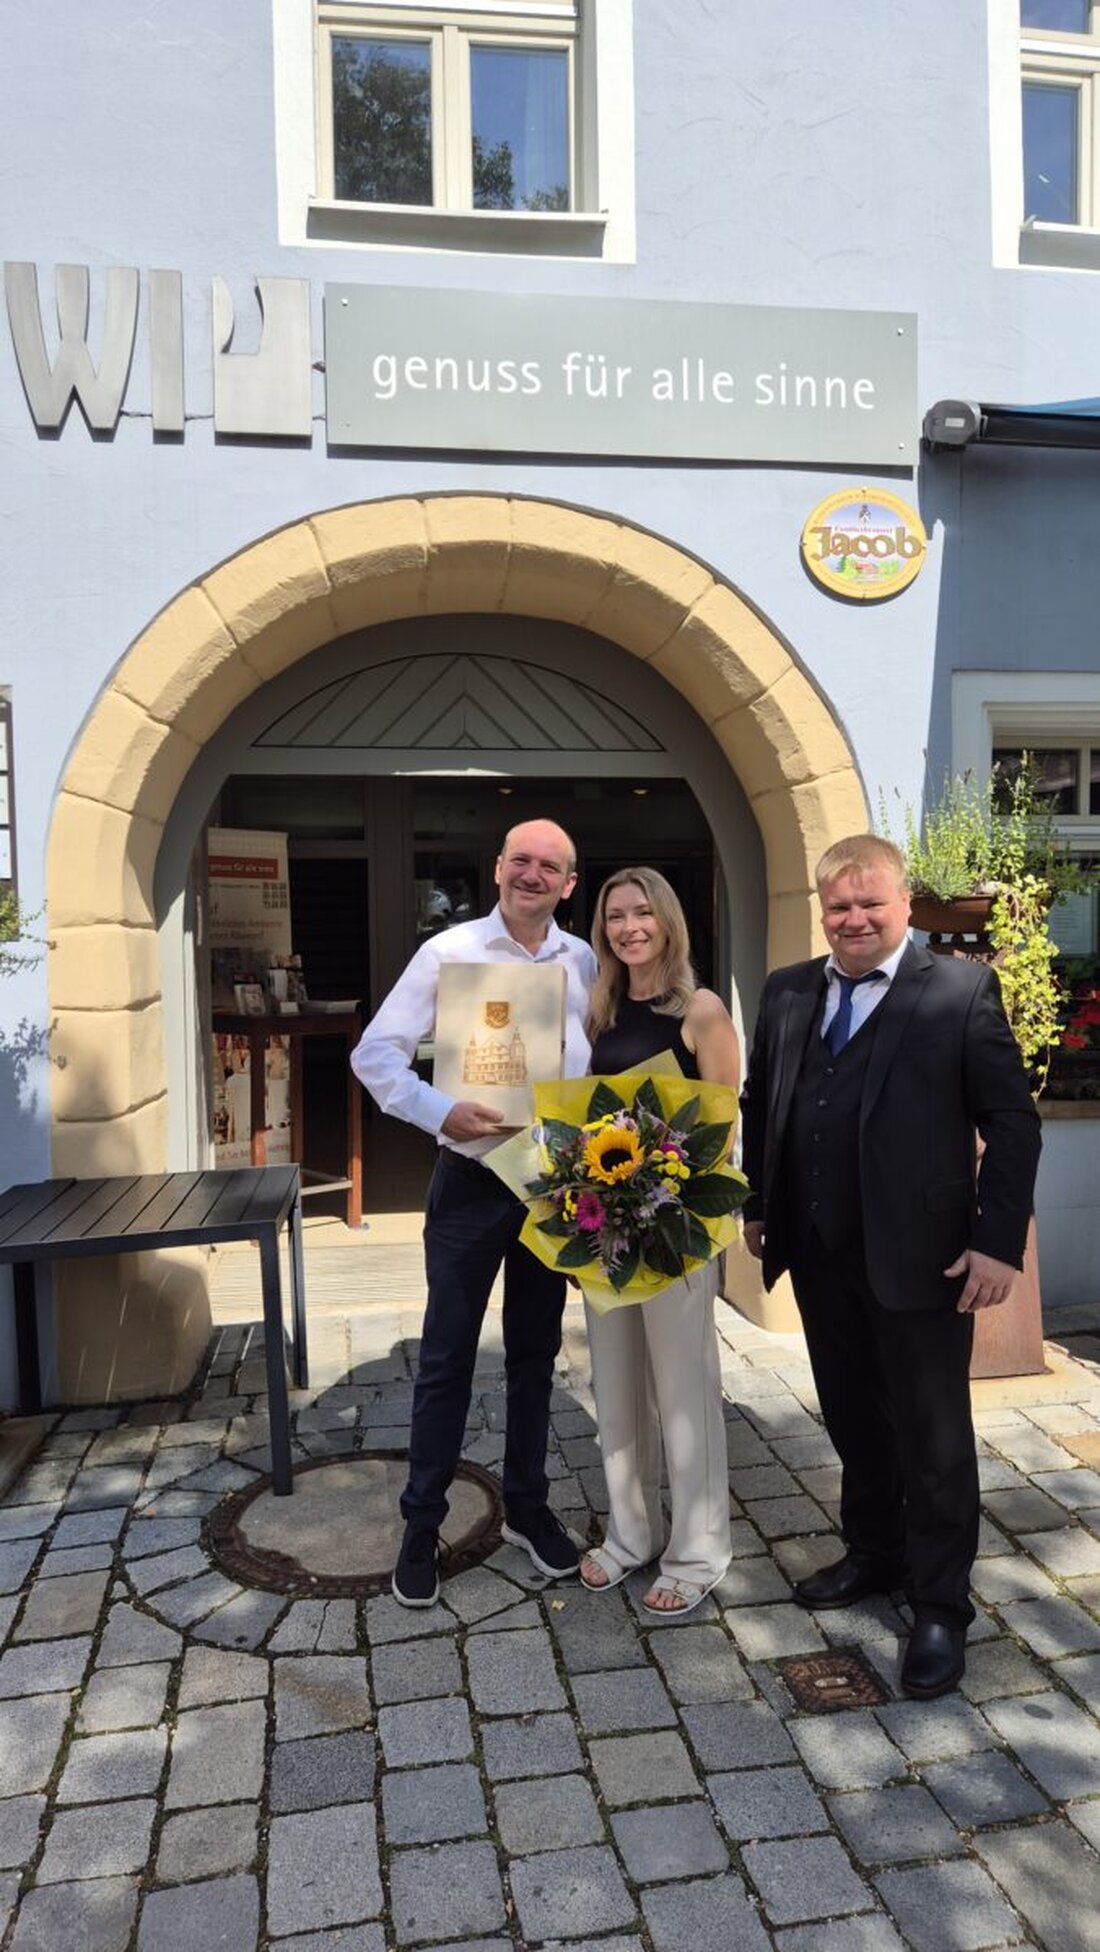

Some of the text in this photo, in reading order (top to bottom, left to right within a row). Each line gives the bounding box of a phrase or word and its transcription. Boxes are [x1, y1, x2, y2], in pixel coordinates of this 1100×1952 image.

[372, 352, 876, 410] genuss für alle sinne
[809, 526, 922, 561] Jacob
